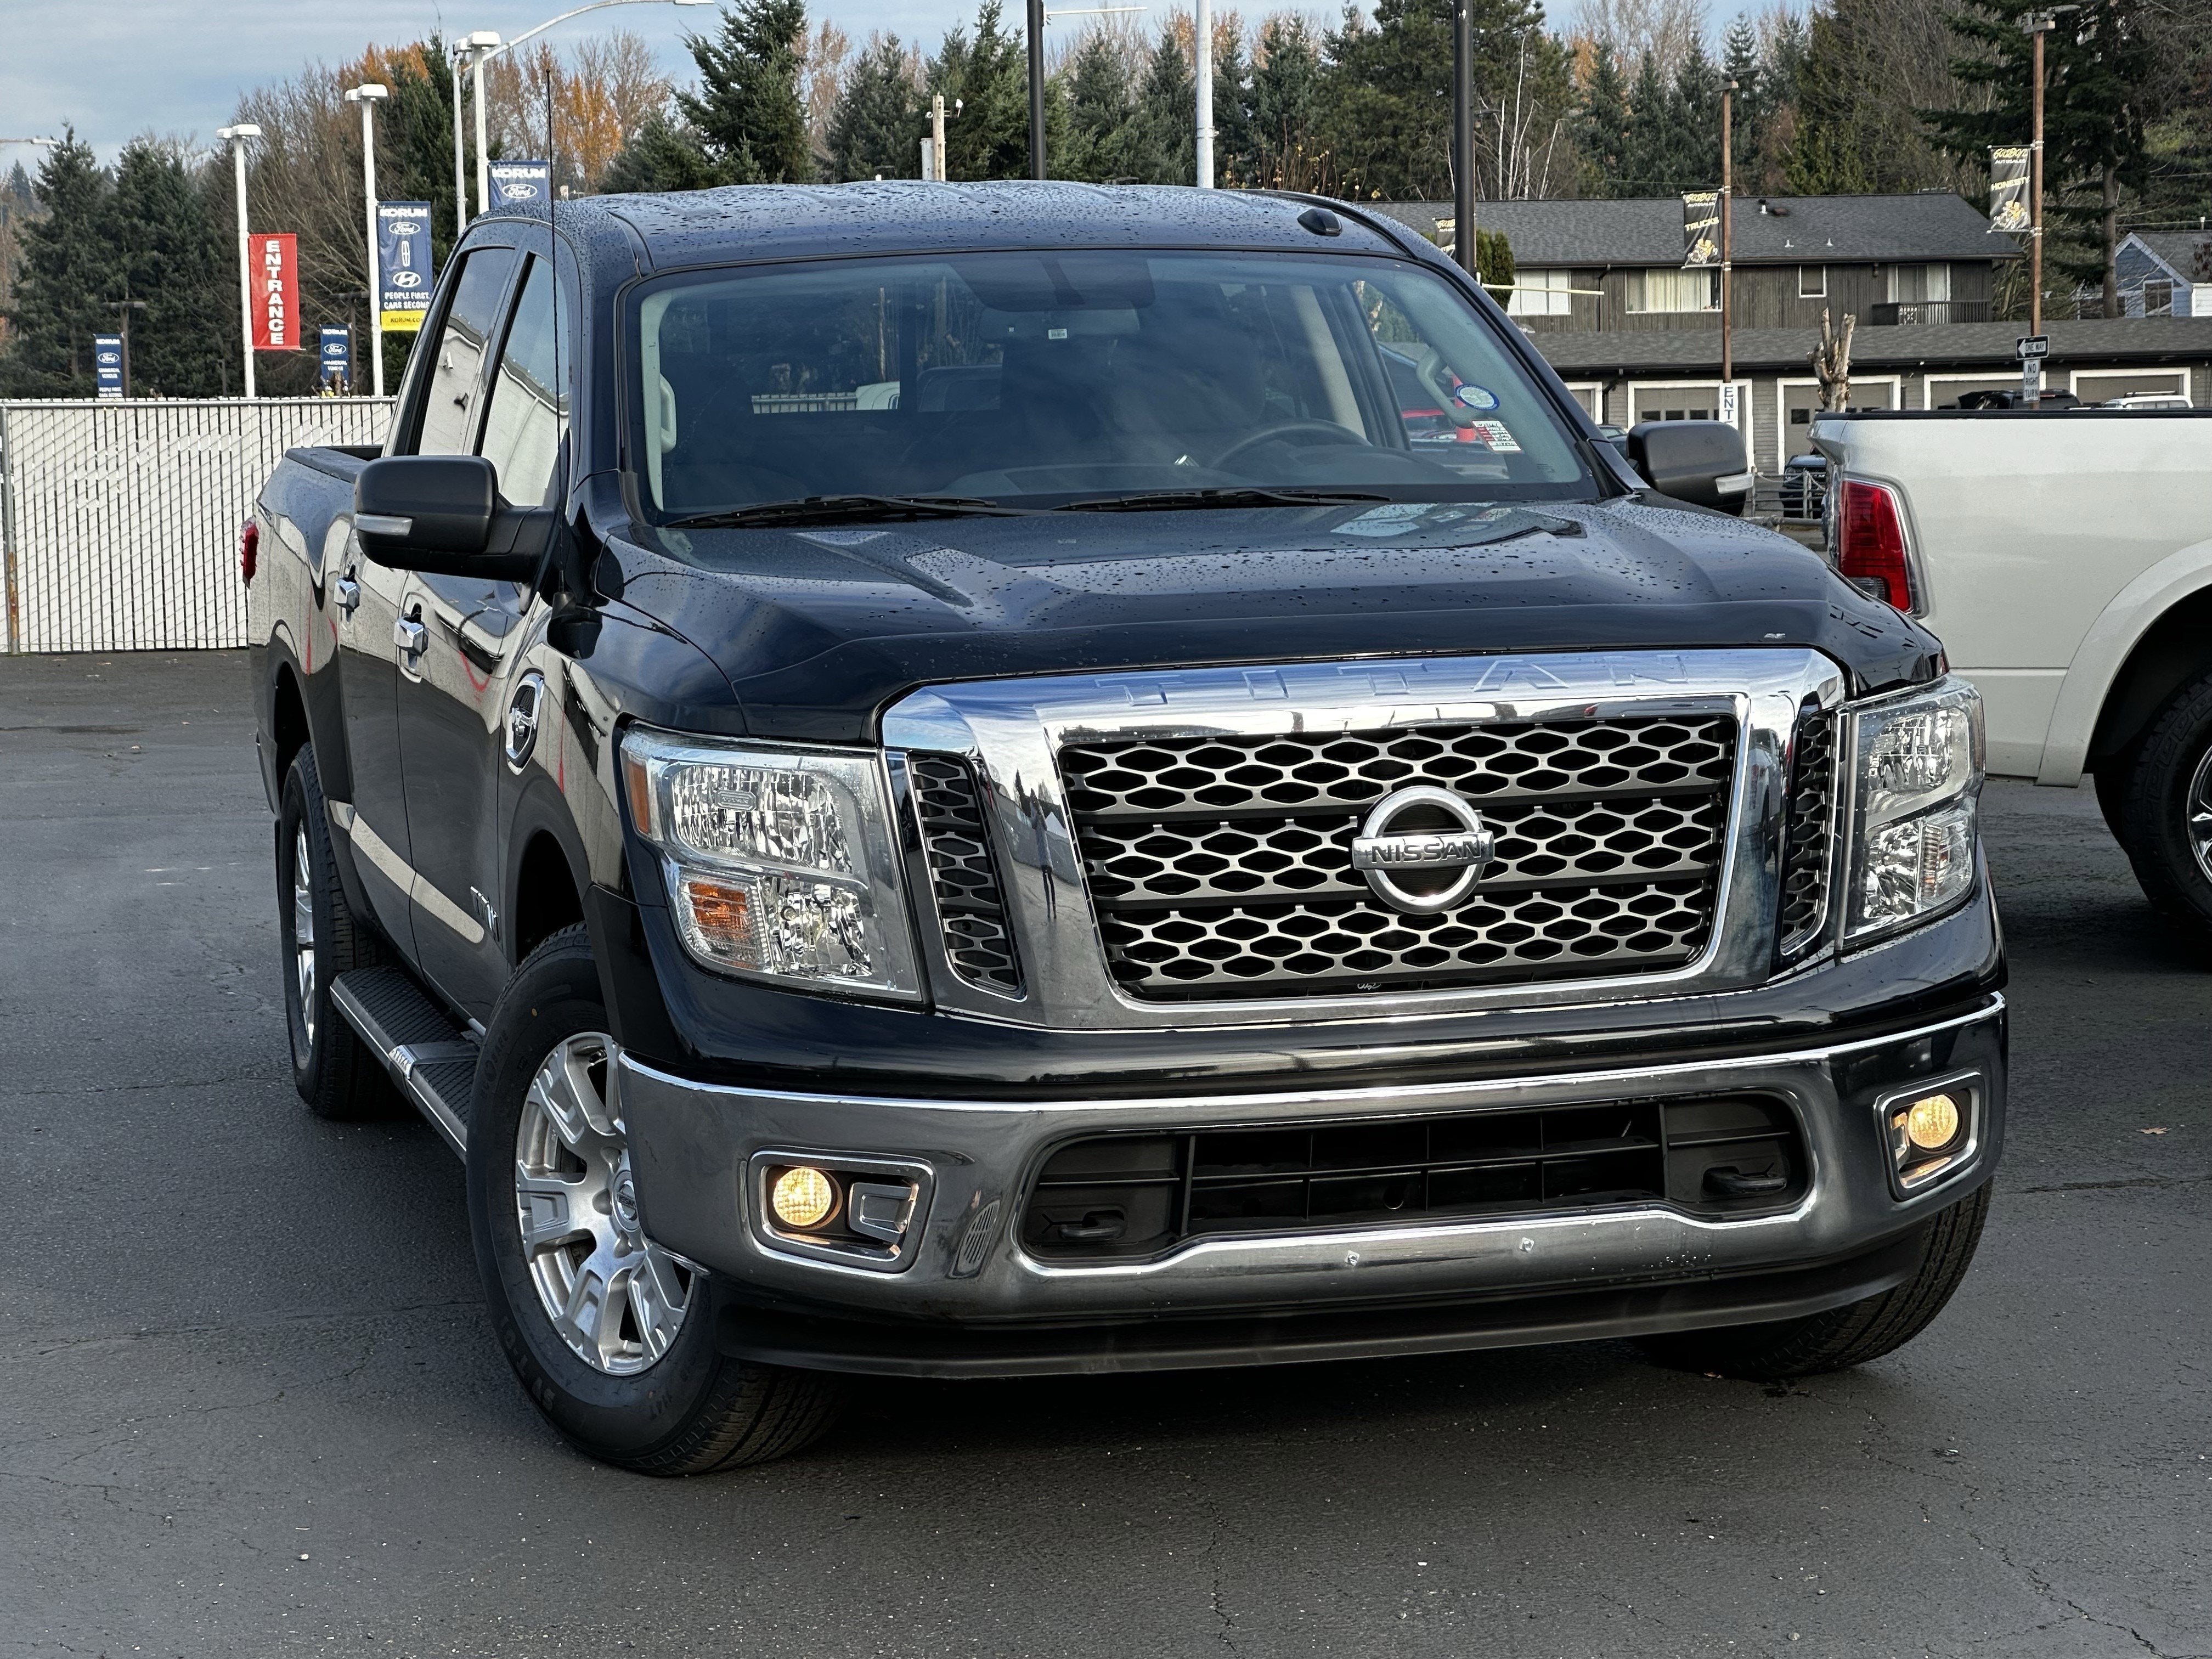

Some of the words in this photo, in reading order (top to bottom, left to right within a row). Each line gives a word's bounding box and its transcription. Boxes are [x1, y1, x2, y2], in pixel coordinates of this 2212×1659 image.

[492, 168, 546, 178] KORUM
[1991, 176, 2030, 191] HONESTY
[507, 185, 532, 197] Ford
[380, 208, 427, 217] KORUM
[392, 222, 416, 234] Ford
[1685, 217, 1719, 231] TRUCKS
[266, 240, 284, 345] ENTRANCE
[2025, 343, 2034, 352] ONE
[2036, 342, 2045, 351] WAY
[2028, 363, 2036, 374] NO
[2025, 389, 2038, 398] TURN
[1724, 386, 1734, 424] ENT
[1095, 654, 1690, 706] TITAN
[1371, 840, 1482, 864] NISSAN
